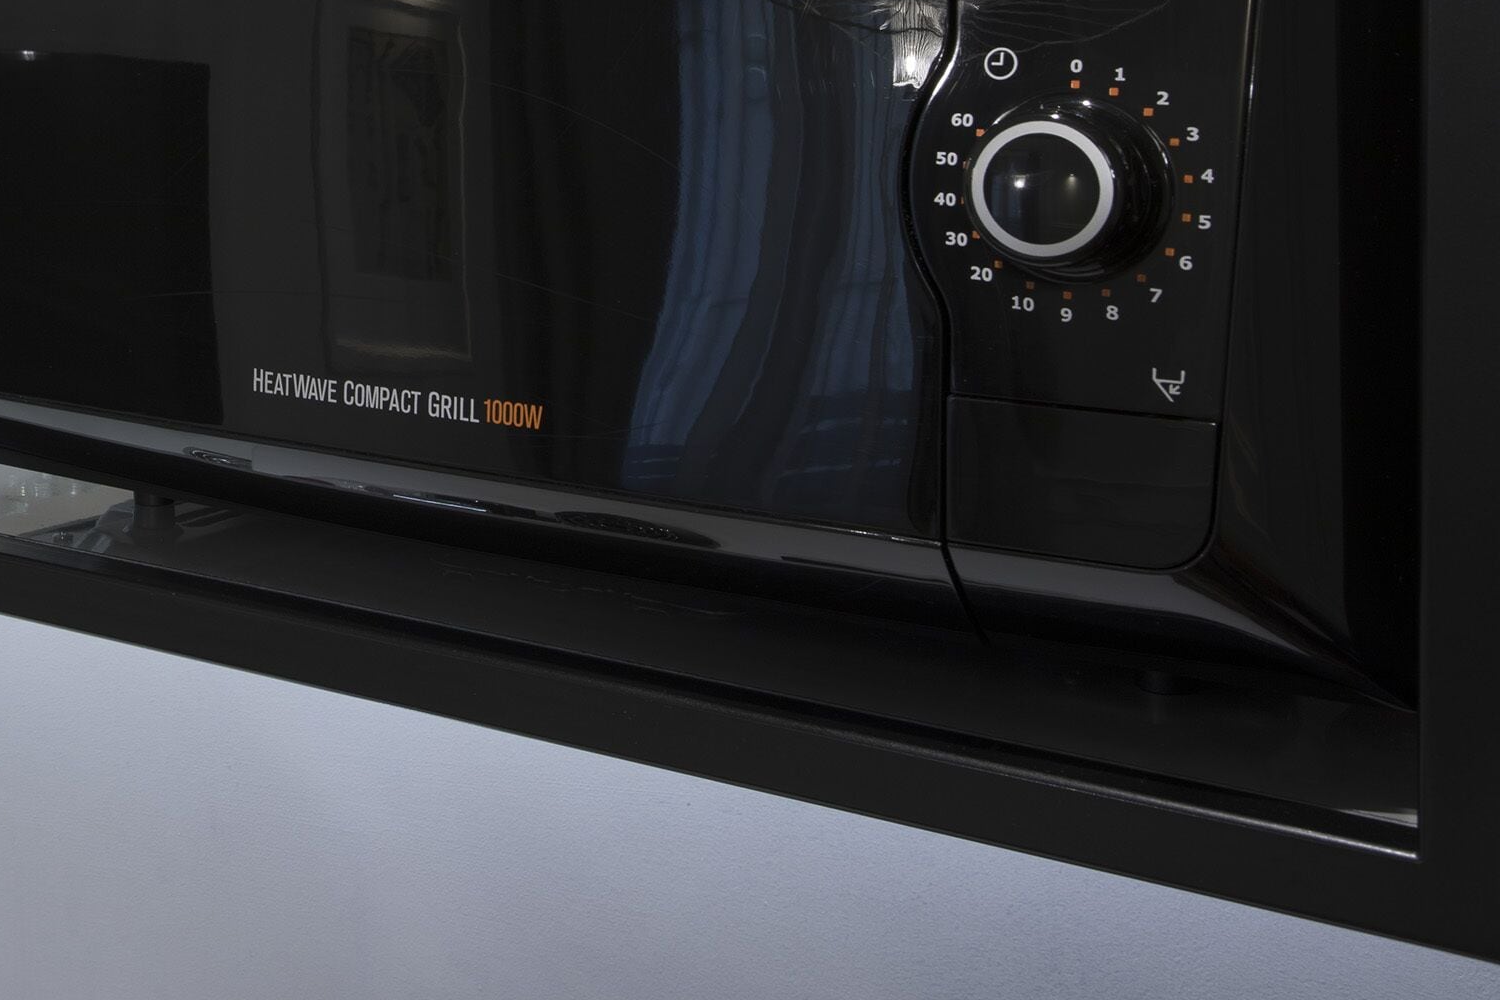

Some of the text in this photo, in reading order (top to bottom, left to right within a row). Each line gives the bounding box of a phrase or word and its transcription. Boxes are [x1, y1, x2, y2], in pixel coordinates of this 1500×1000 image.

[1069, 58, 1084, 74] 0
[1114, 67, 1126, 82] 1
[1156, 90, 1170, 106] 2
[950, 112, 974, 128] 60
[1186, 126, 1200, 142] 3
[935, 151, 959, 166] 50
[1200, 168, 1215, 184] 4
[933, 191, 957, 207] 40
[1197, 214, 1212, 230] 5
[945, 231, 968, 247] 30
[1179, 255, 1193, 271] 6
[970, 266, 994, 282] 20
[1149, 287, 1163, 303] 7
[1011, 295, 1035, 312] 10
[1060, 307, 1073, 323] 9
[1106, 305, 1119, 321] 8
[484, 399, 542, 429] 1000W
